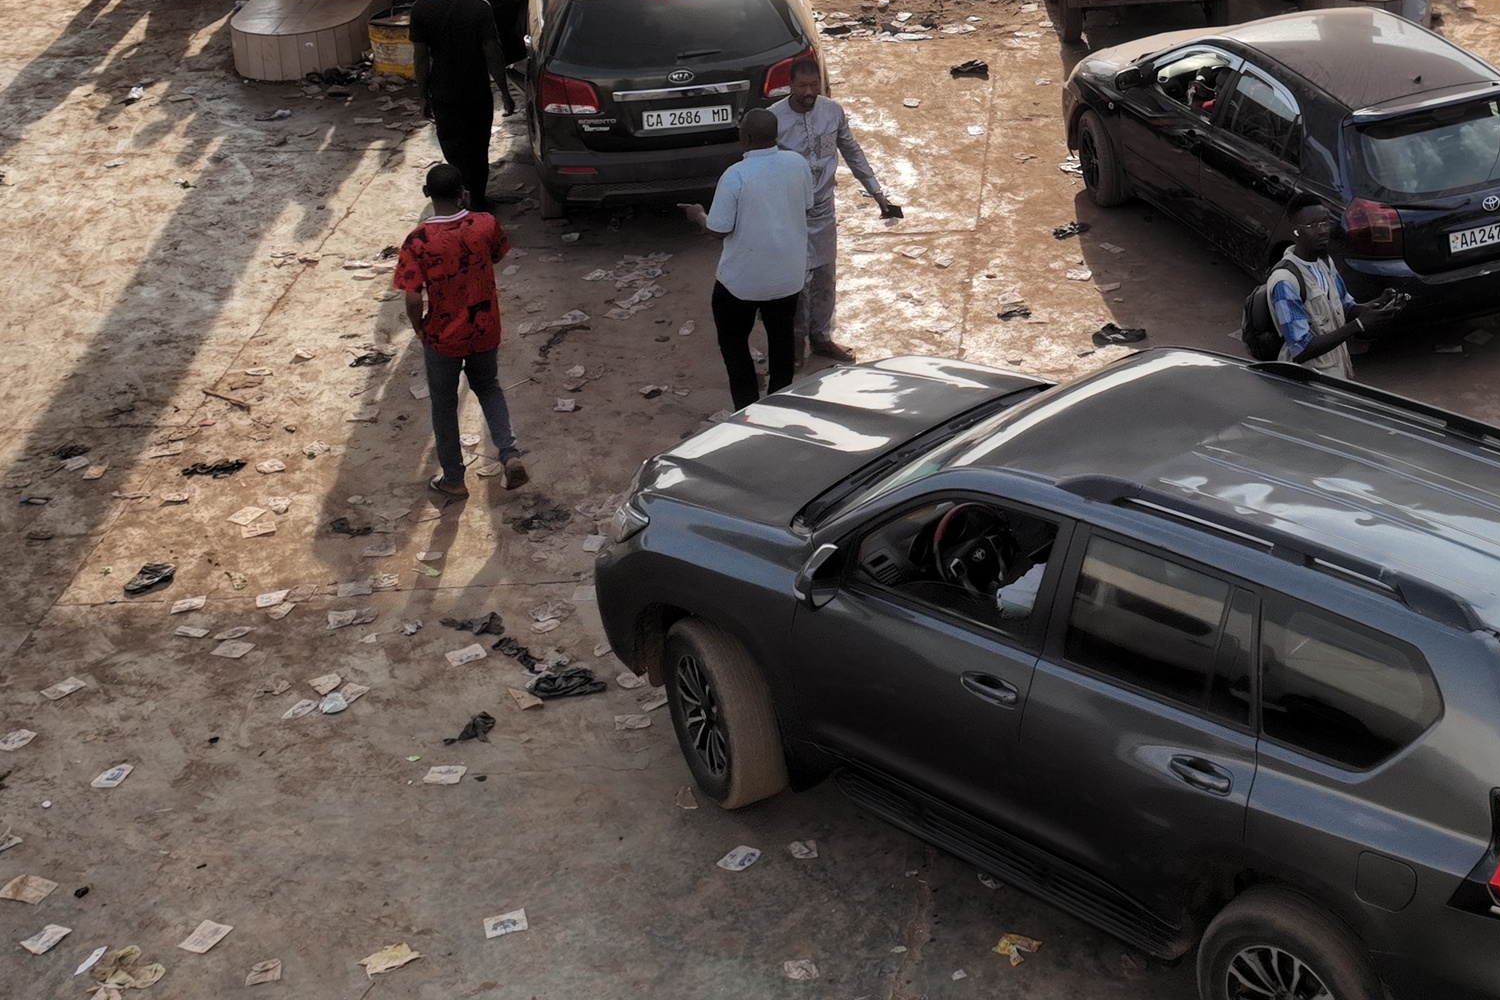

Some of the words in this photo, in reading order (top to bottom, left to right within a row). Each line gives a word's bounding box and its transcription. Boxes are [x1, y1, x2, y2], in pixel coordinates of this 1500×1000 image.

[672, 71, 690, 81] KIA
[646, 113, 663, 127] CA
[669, 111, 701, 126] 2686
[712, 108, 729, 122] MD
